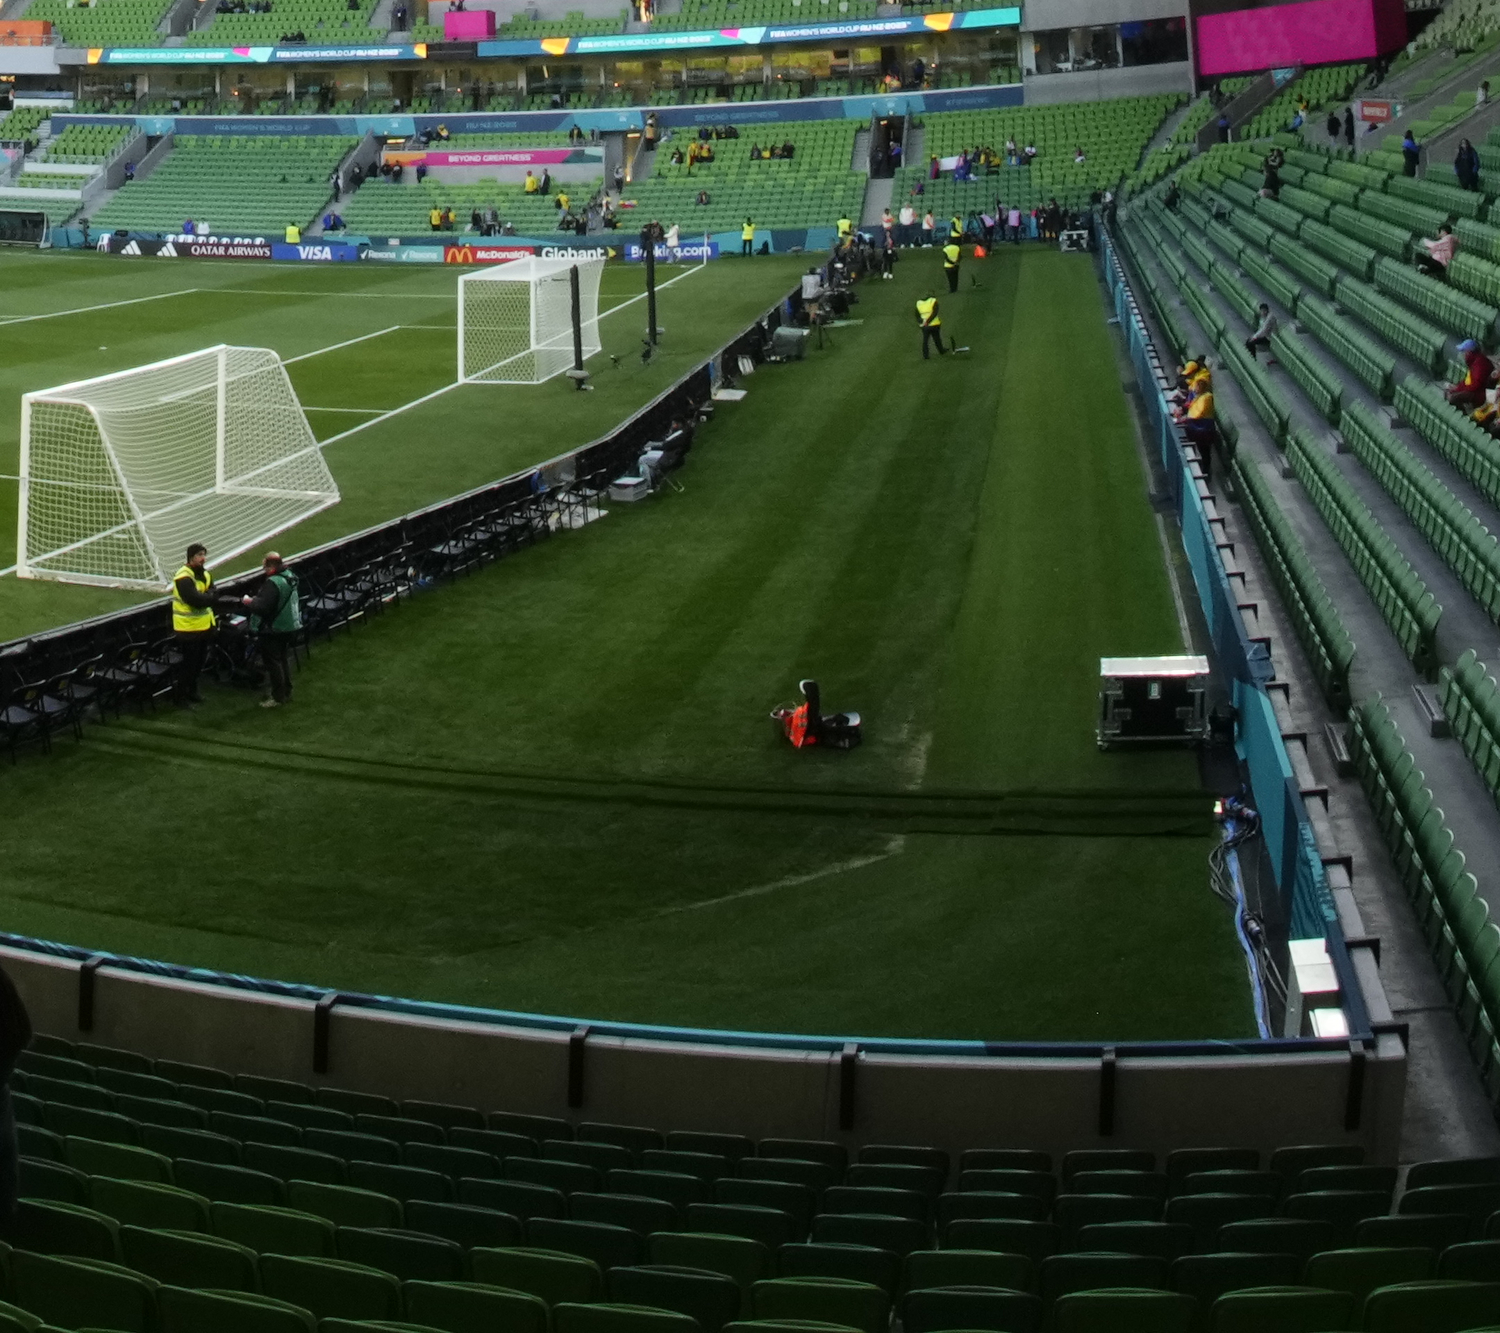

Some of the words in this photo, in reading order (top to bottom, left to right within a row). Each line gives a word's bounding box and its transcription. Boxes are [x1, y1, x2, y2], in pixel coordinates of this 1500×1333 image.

[820, 26, 845, 35] WORLD
[448, 154, 481, 163] BEYOND
[482, 153, 532, 162] GREATNESS
[191, 244, 225, 257] QATAR
[227, 245, 271, 258] AIRWAYS
[297, 246, 332, 260] VISA
[368, 249, 396, 259] Rexona
[409, 249, 438, 260] Rexona
[476, 250, 531, 260] McDonald's
[541, 246, 606, 261] Globant
